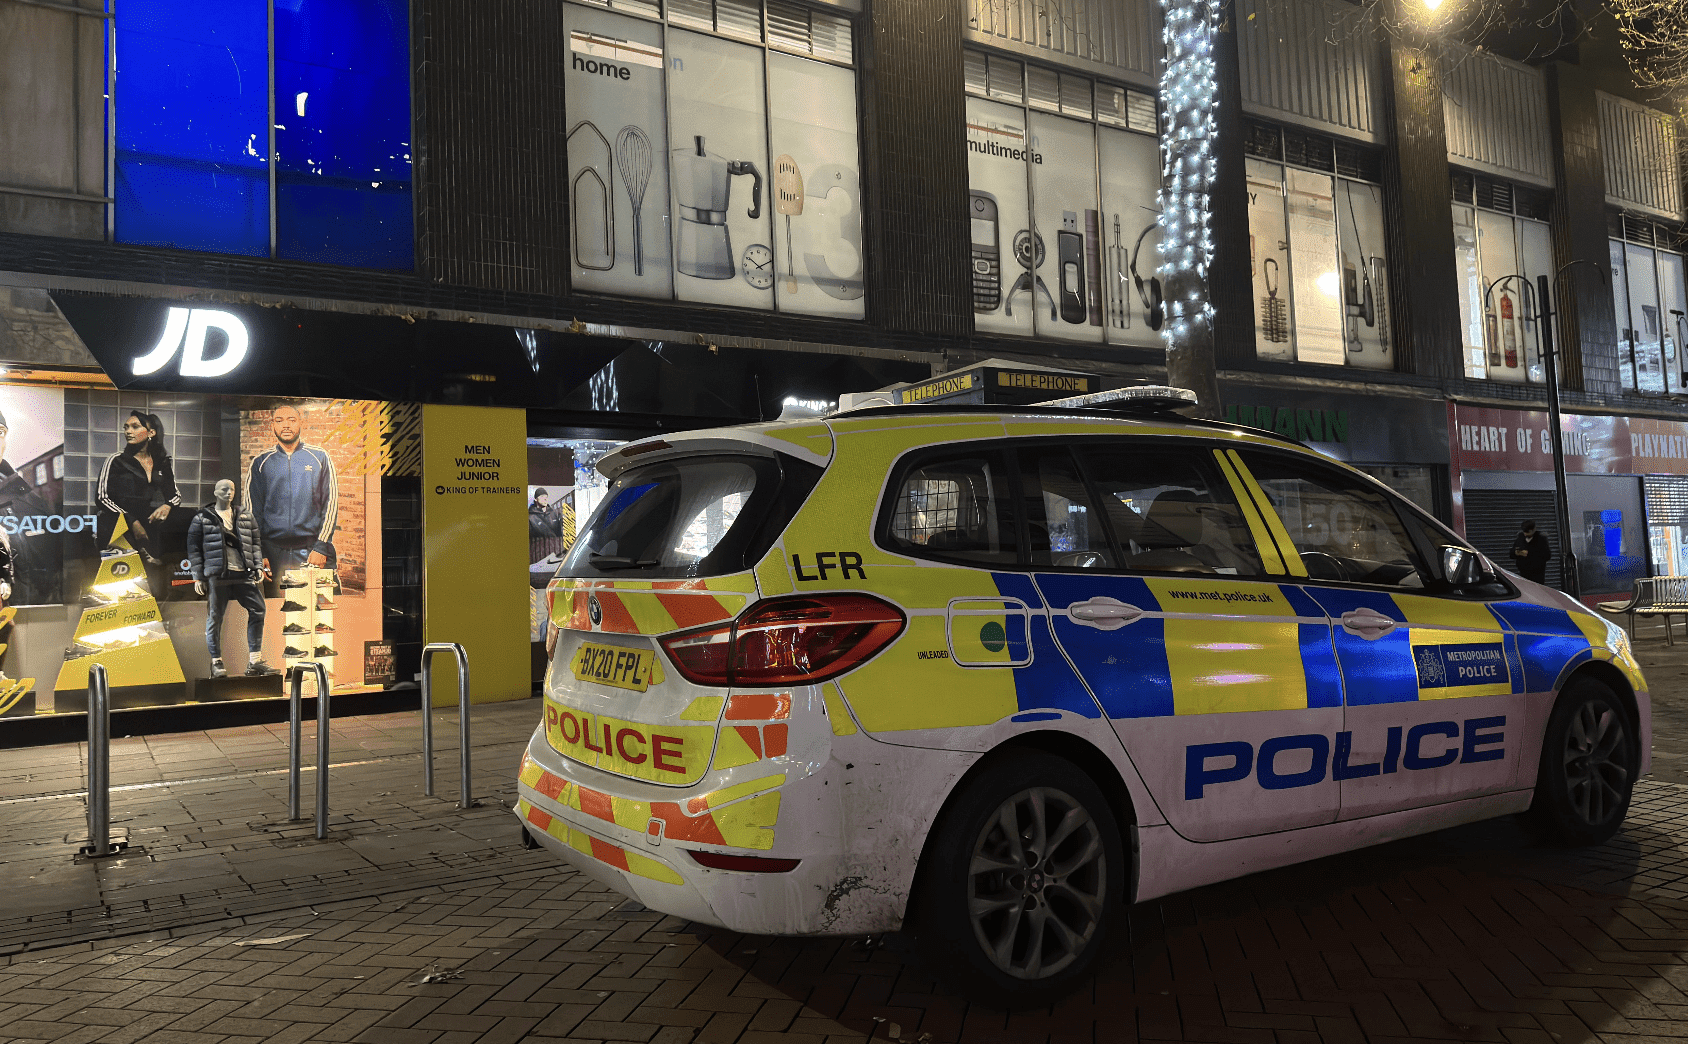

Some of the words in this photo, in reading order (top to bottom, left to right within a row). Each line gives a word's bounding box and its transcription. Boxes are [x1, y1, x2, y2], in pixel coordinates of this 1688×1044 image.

[572, 52, 631, 80] home
[132, 306, 249, 378] JD
[908, 376, 966, 402] TELEPHONE
[1005, 373, 1081, 391] TELEPHONE
[1460, 425, 1508, 452] HEART
[1516, 427, 1533, 453] OF
[1630, 432, 1688, 458] PLAYNATI
[464, 445, 491, 455] MEN
[454, 458, 501, 467] WOMEN
[457, 471, 500, 480] JUNIOR
[446, 486, 467, 494] KING
[468, 486, 479, 494] OF
[480, 486, 521, 495] TRAINERS
[112, 564, 129, 575] JD
[792, 552, 868, 581] LFR
[1168, 590, 1274, 603] www.met.police.uk
[85, 609, 118, 624] FOREVER
[123, 610, 156, 623] FORWARD
[917, 650, 949, 660] UNLEADED
[1446, 650, 1501, 662] METROPOLITAN
[580, 647, 614, 679] BX20
[613, 651, 642, 685] FPL
[1458, 665, 1498, 678] POLICE
[547, 704, 687, 775] POLICE
[1184, 715, 1507, 801] POLICE
